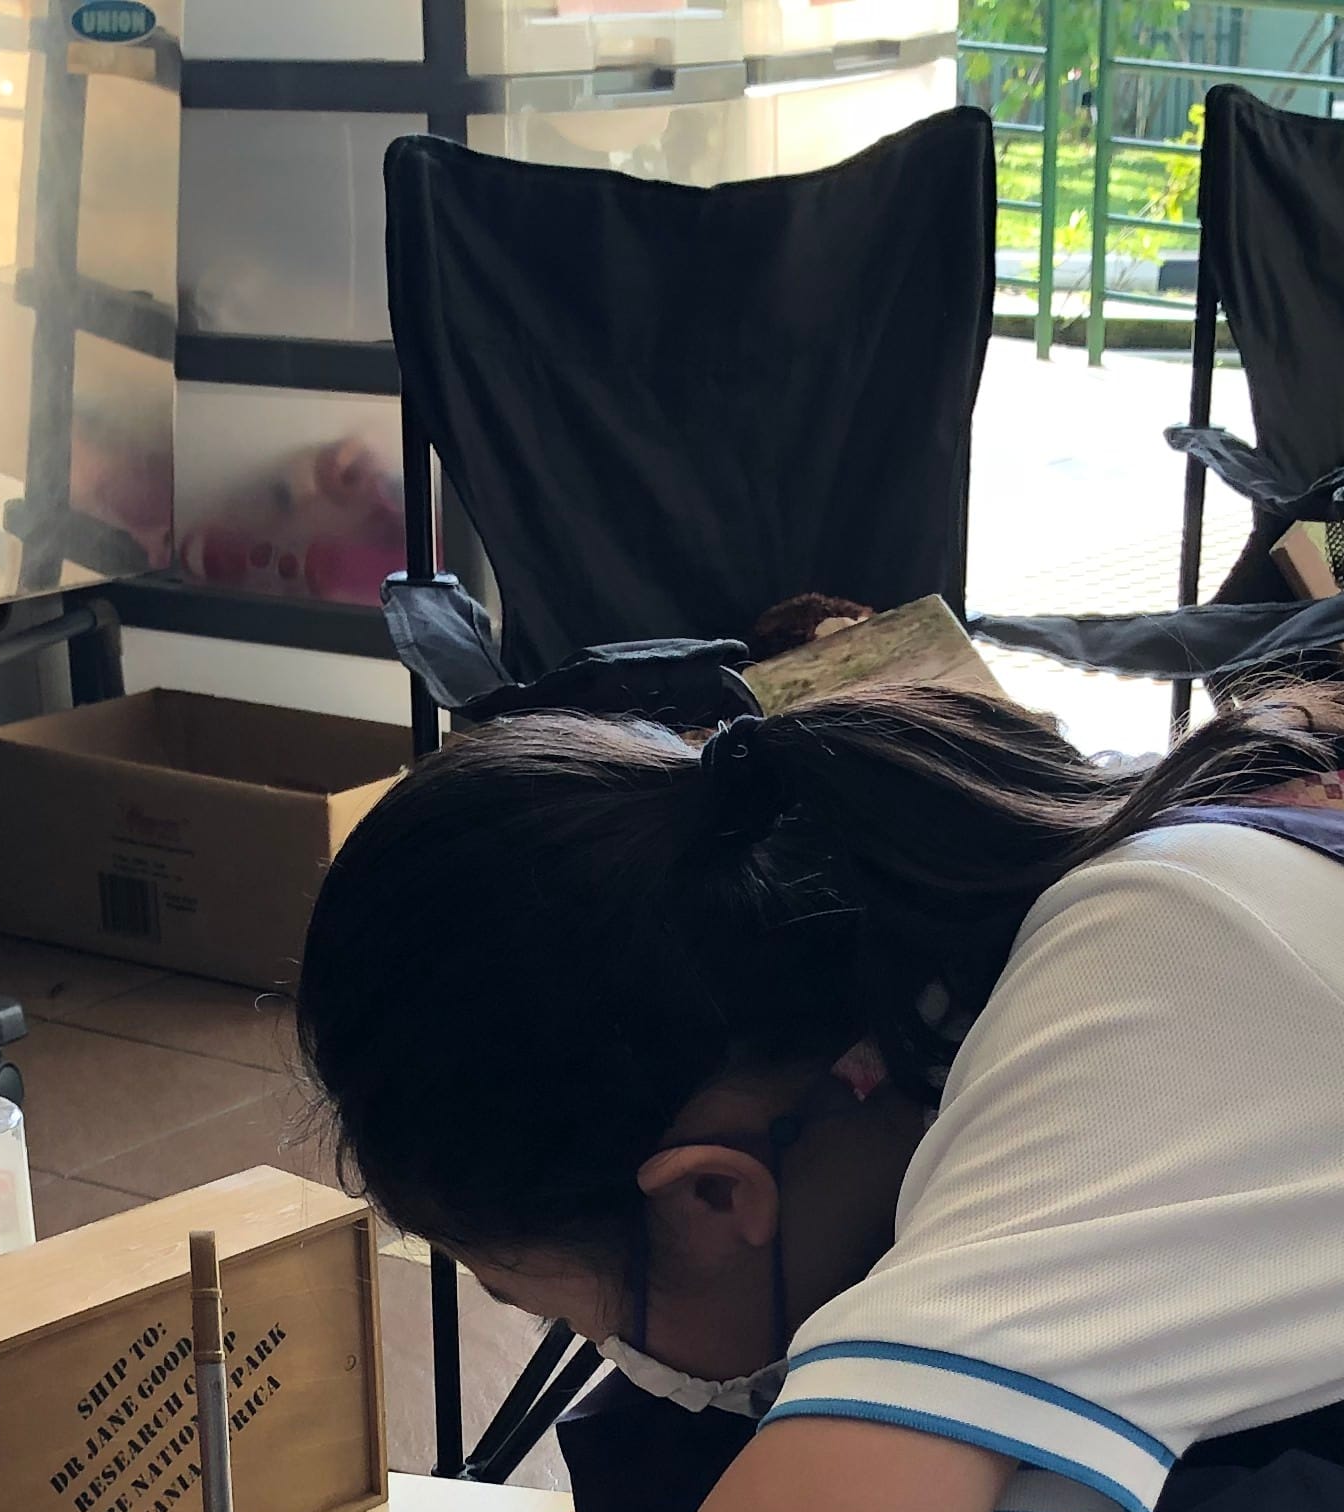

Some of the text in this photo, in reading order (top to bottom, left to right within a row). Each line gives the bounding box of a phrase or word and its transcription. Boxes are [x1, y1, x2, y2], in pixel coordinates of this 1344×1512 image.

[82, 10, 145, 33] UNION
[76, 1322, 167, 1421] SHIP TO:
[183, 1330, 237, 1396] CP
[229, 1321, 288, 1389] PARK
[49, 1456, 86, 1495] DR
[87, 1394, 139, 1461] JANE
